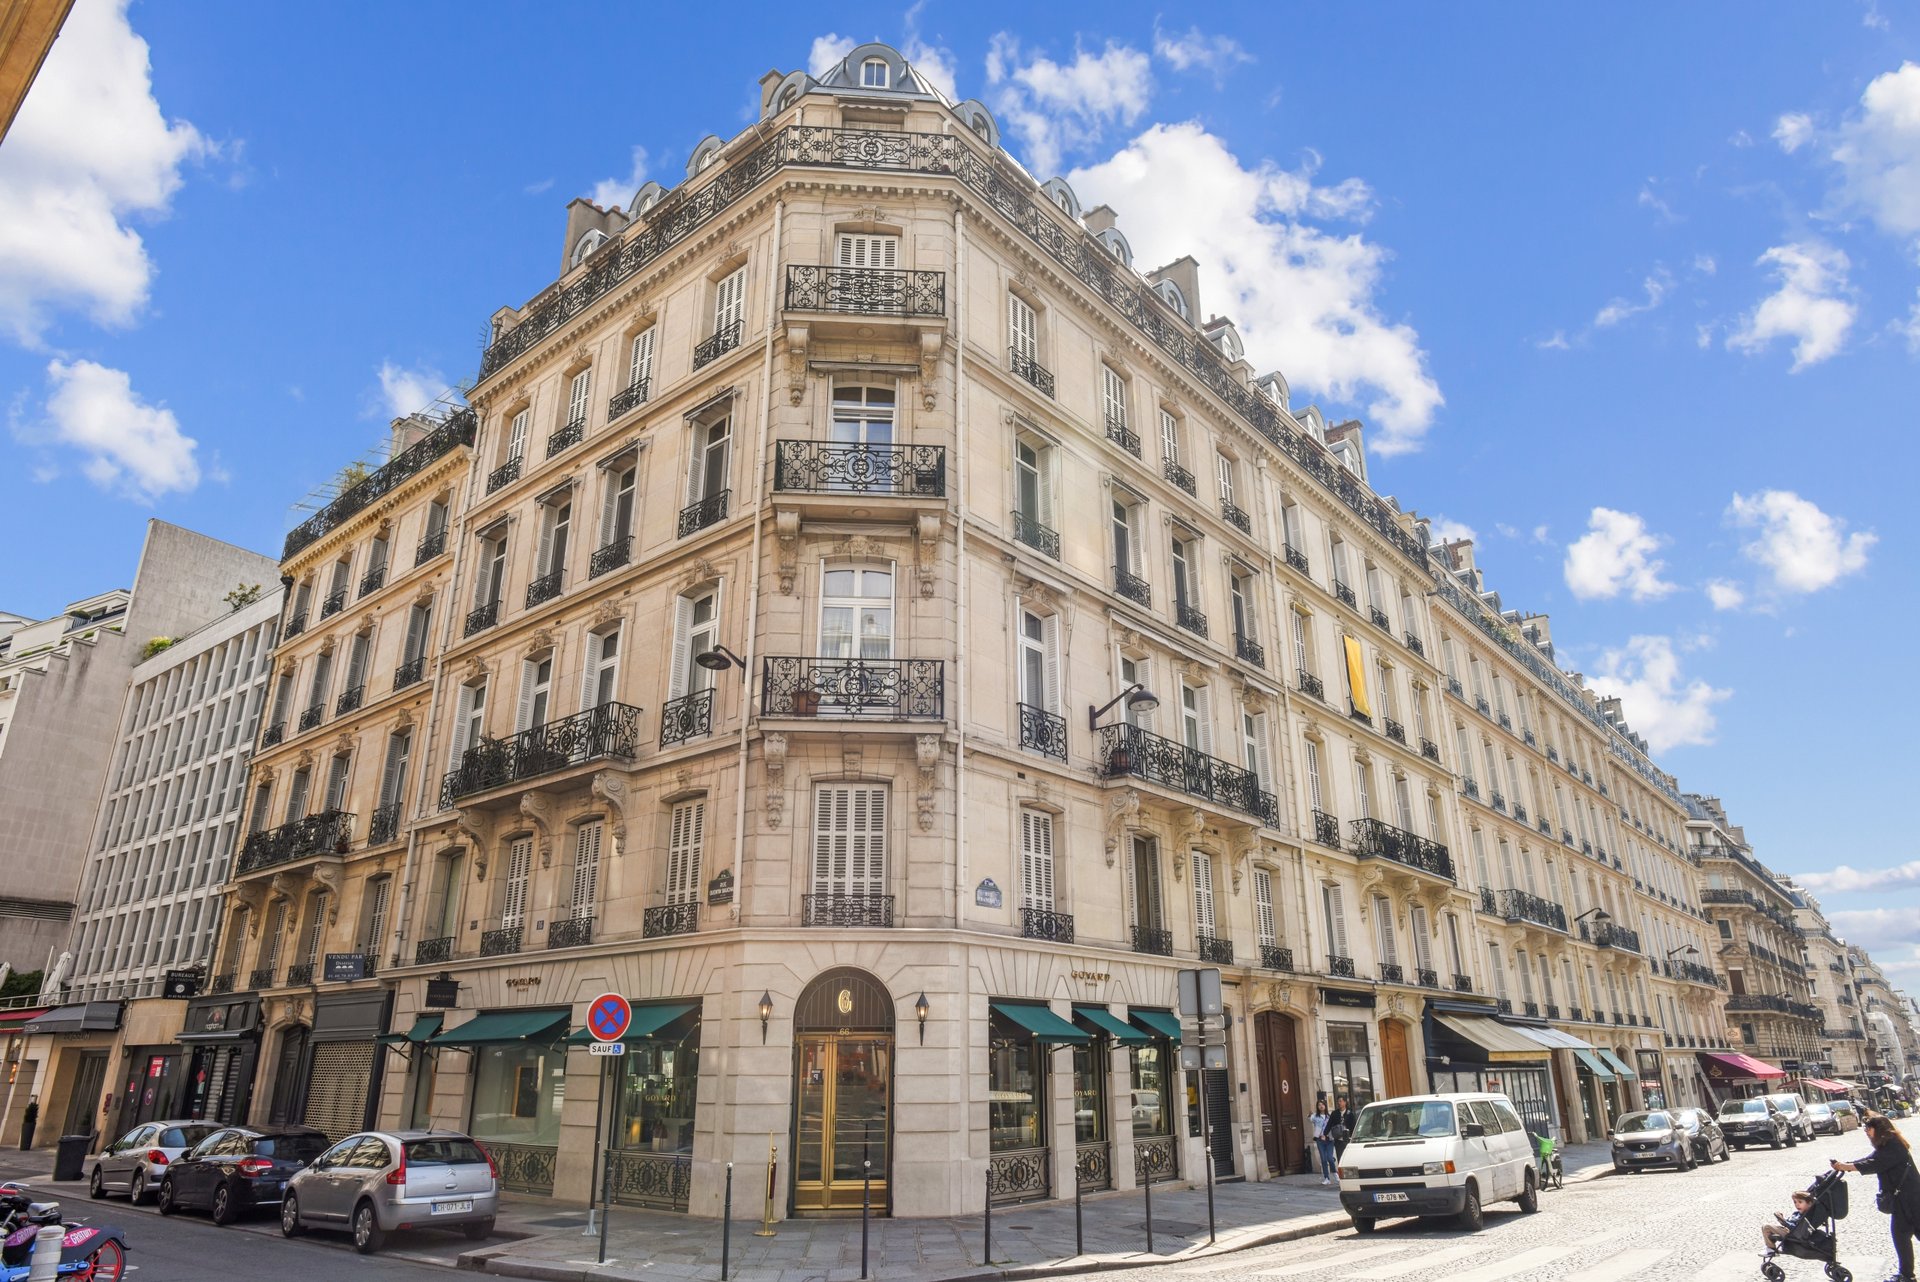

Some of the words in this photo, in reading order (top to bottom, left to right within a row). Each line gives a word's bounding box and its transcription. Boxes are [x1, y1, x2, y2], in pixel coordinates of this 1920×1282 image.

[1071, 970, 1110, 982] GOYARD
[505, 977, 541, 987] GOYARD
[840, 1028, 850, 1036] 66
[592, 1045, 612, 1053] SAUF
[645, 1094, 676, 1102] GOYARD
[69, 1228, 93, 1245] GRATUIT
